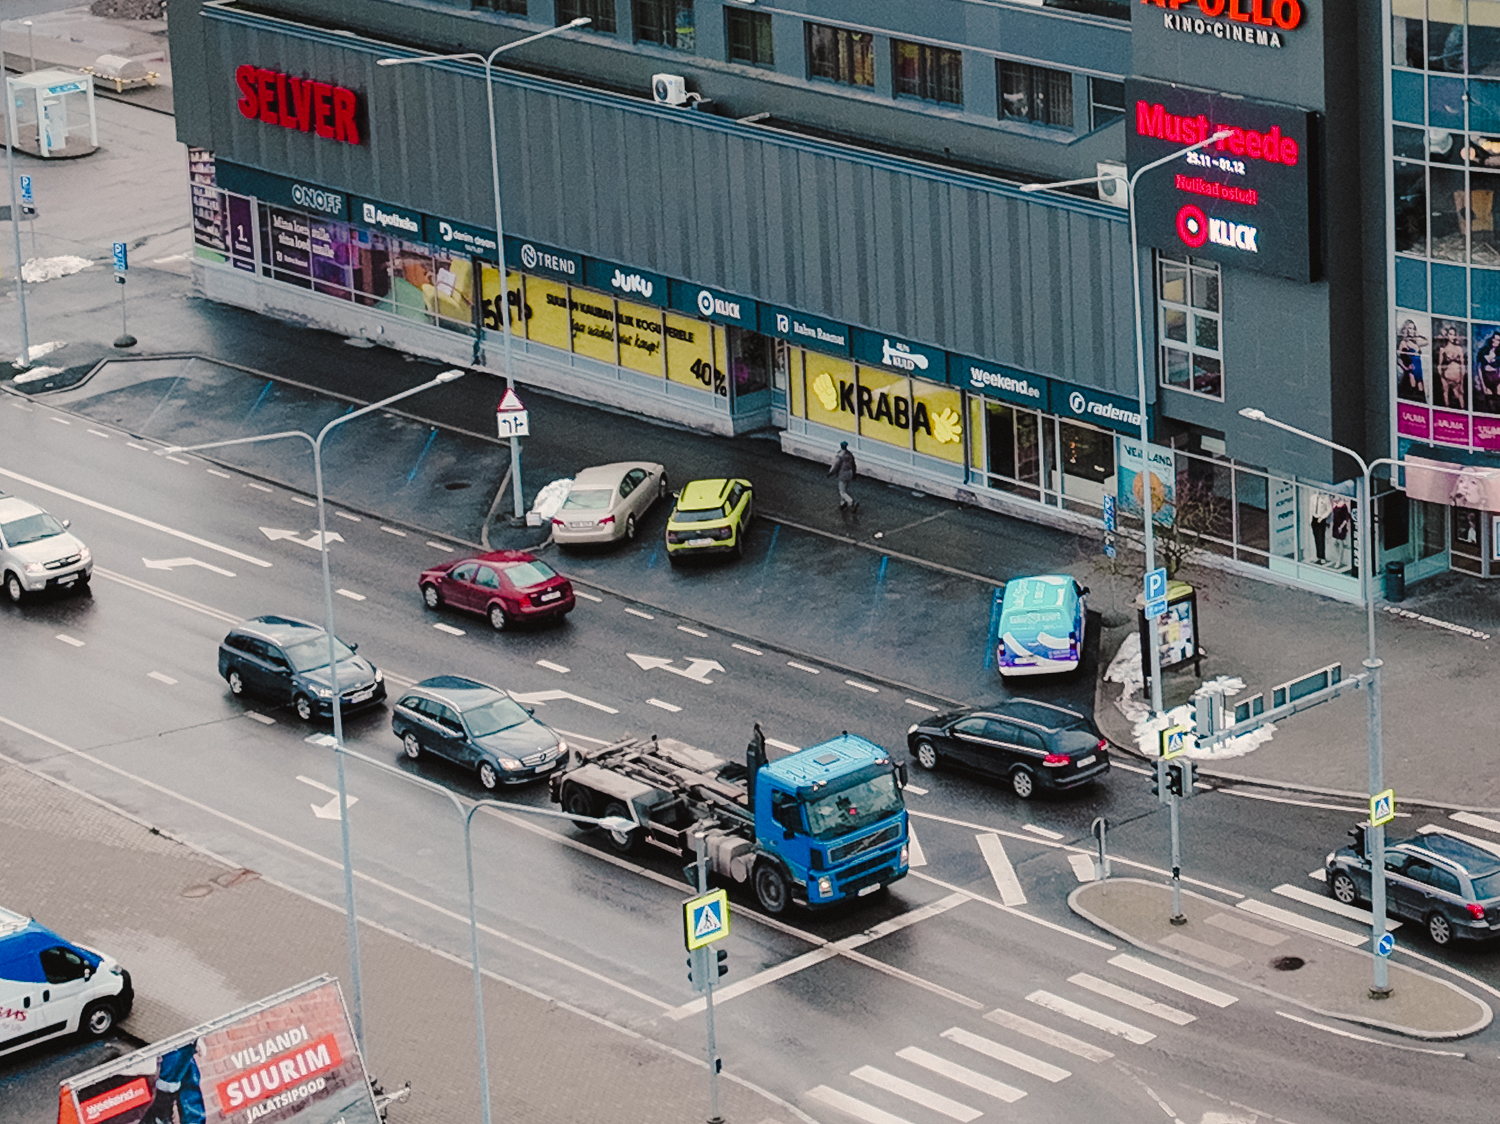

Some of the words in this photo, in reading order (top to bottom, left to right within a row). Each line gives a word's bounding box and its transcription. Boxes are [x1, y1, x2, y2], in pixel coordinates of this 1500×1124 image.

[235, 64, 360, 145] SELVER
[1136, 99, 1209, 147] Must
[1214, 124, 1299, 167] reede
[291, 183, 342, 215] ONOFF
[1208, 217, 1258, 253] KLICK
[537, 251, 576, 274] TREND
[611, 269, 653, 298] JUKU
[714, 298, 741, 320] KLICK
[690, 358, 728, 397] 40%
[970, 366, 1040, 399] weekend.ee
[838, 381, 932, 436] KRABA
[1086, 400, 1148, 426] radema
[1149, 574, 1161, 597] P
[230, 1025, 309, 1069] VILJANDI
[226, 1044, 332, 1107] SUURIM
[246, 1077, 327, 1124] JALATSIPOOD
